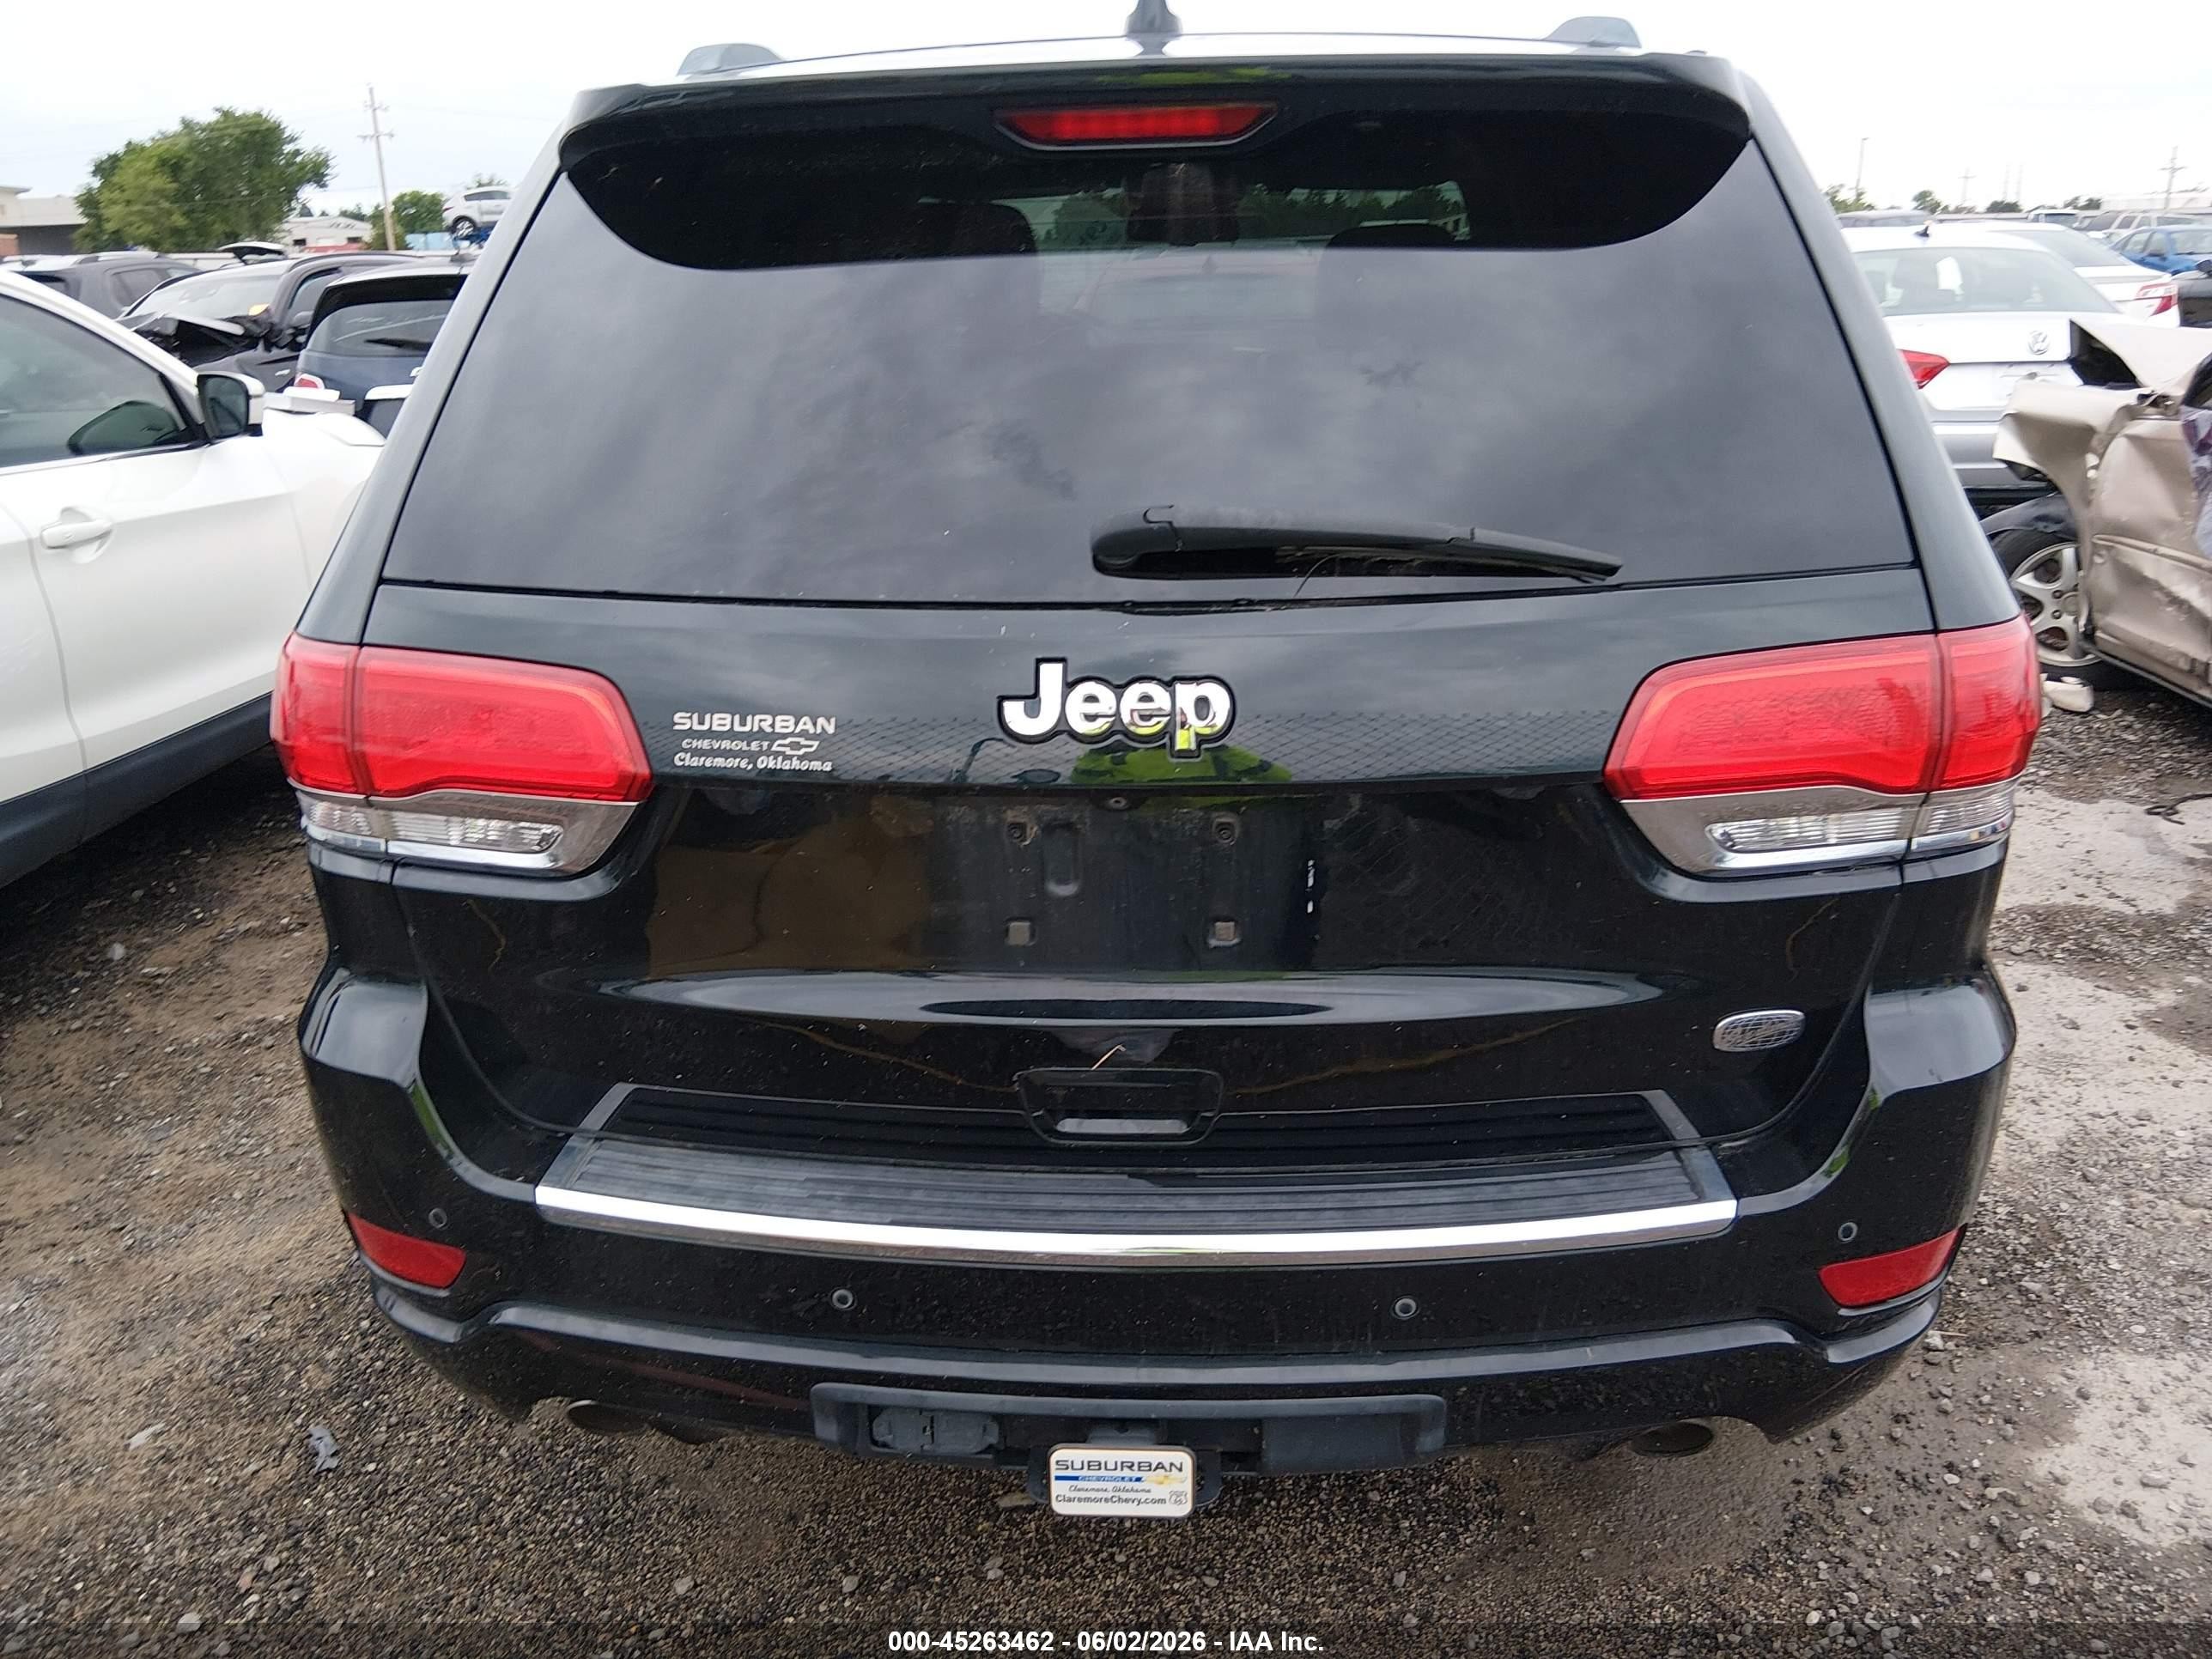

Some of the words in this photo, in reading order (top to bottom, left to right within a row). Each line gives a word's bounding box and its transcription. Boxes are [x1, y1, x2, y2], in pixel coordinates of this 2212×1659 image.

[998, 658, 1235, 758] Jeep
[672, 712, 836, 734] SUBURBAN
[681, 738, 770, 751] CHEVROLET
[673, 752, 752, 770] Claremore,
[757, 756, 832, 772] Oklahoma
[1055, 1460, 1183, 1473] SUBURBAN
